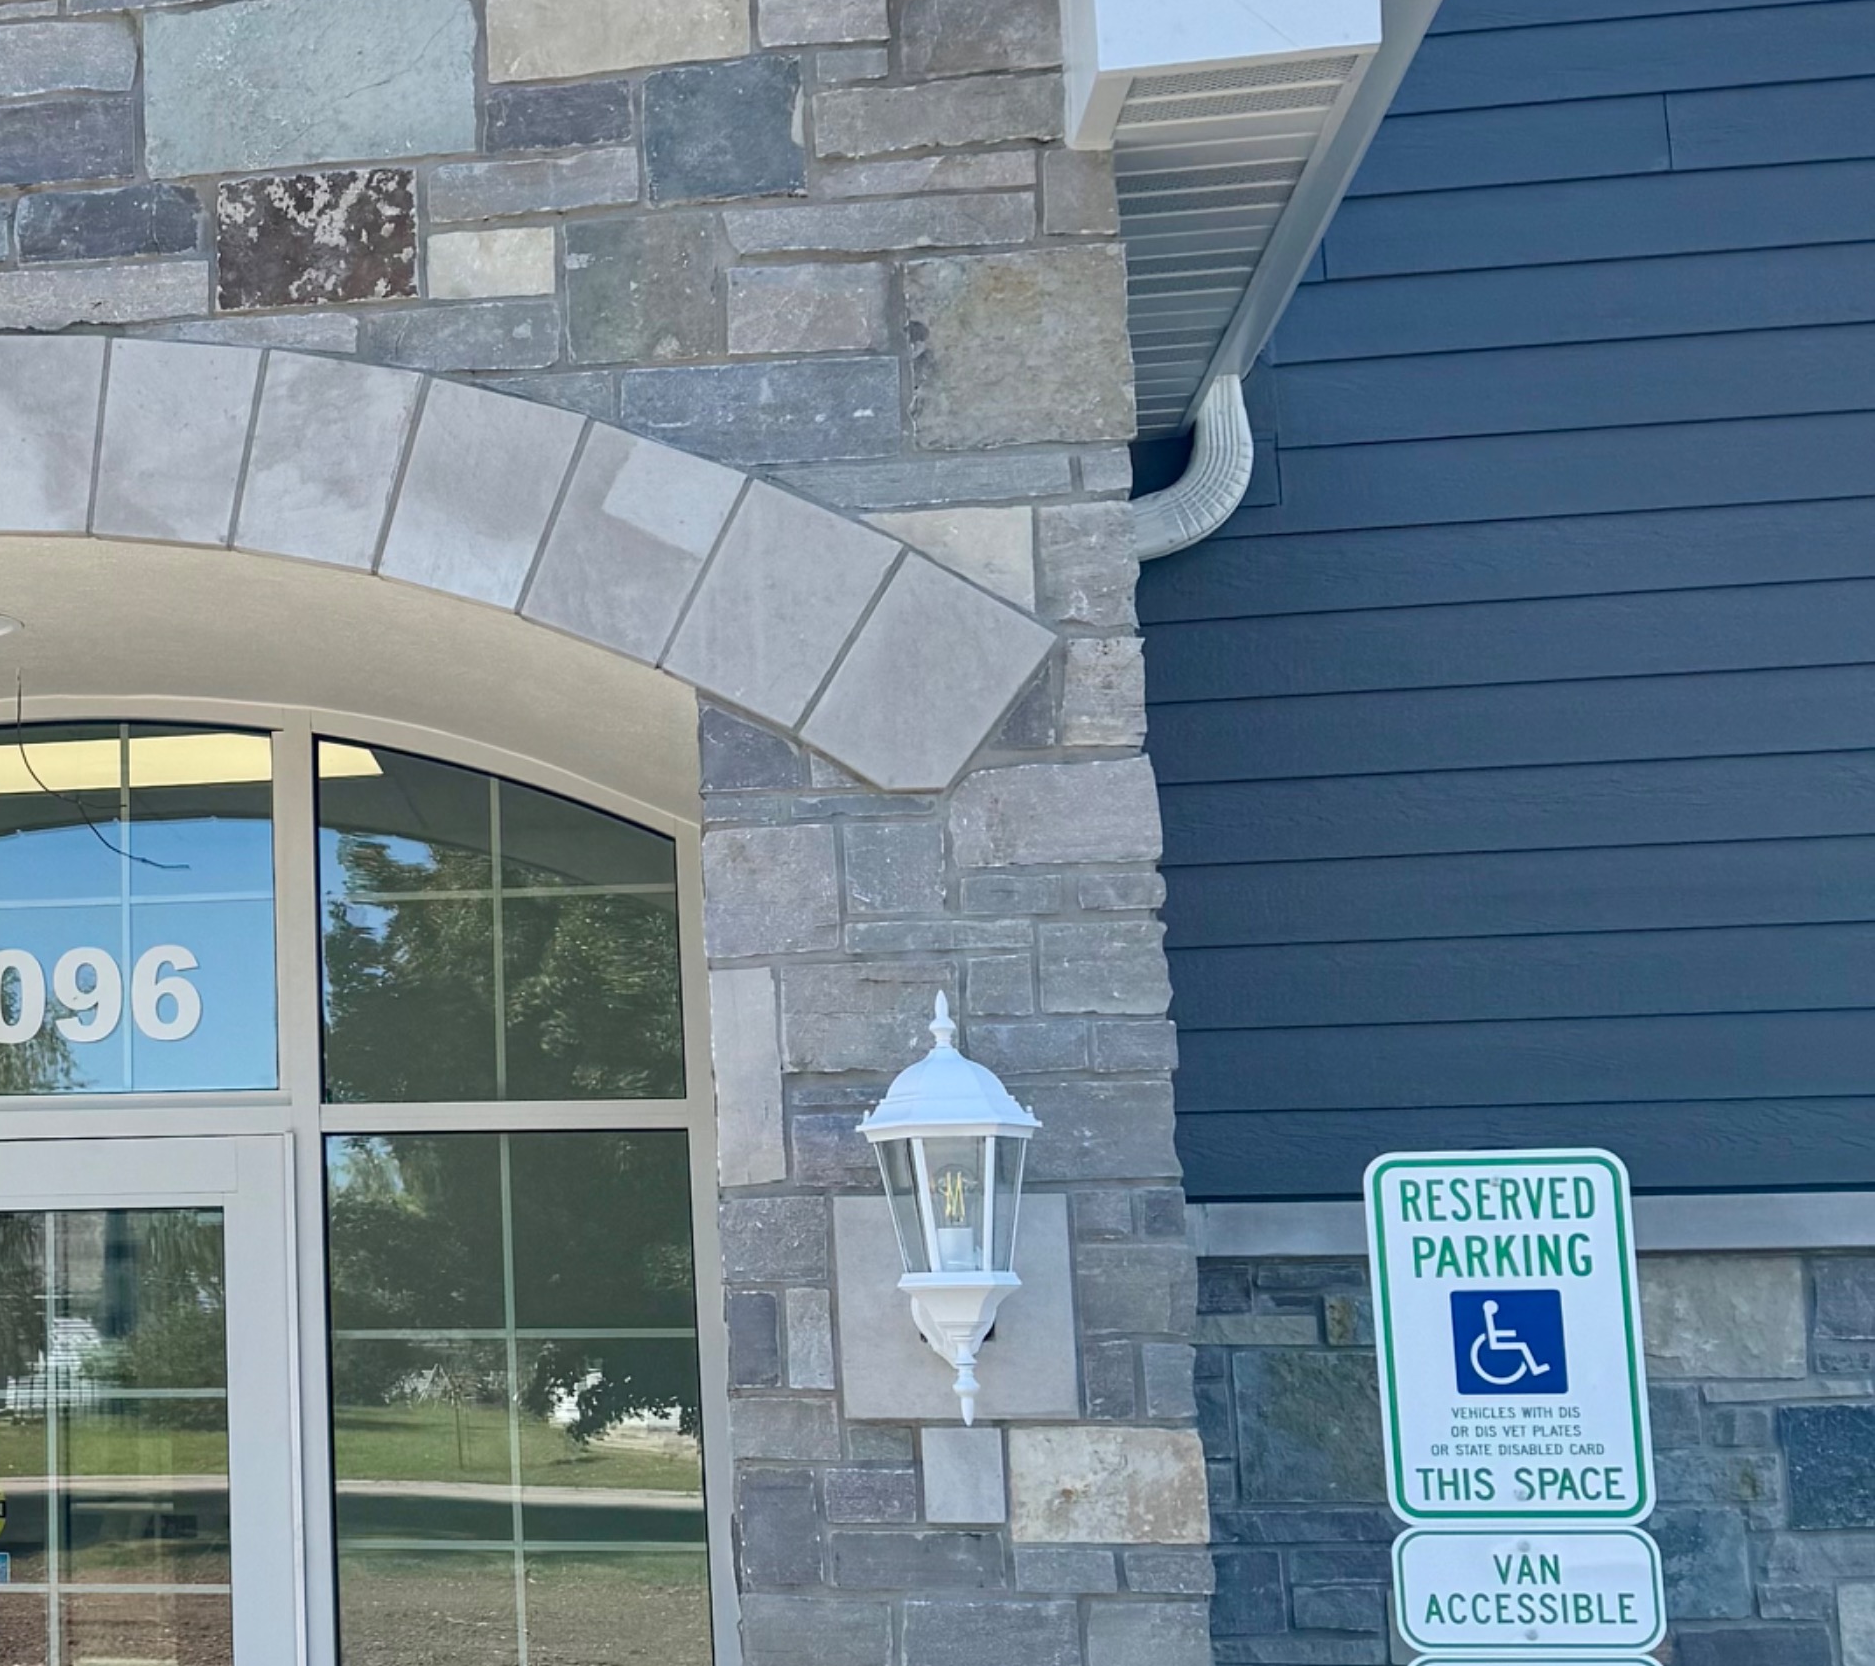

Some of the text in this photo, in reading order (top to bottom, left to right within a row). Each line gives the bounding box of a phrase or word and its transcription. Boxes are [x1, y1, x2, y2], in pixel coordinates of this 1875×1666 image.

[1399, 1177, 1596, 1223] RESERVED
[1411, 1233, 1594, 1278] PARKING
[1451, 1405, 1581, 1420] VEHICLES WITH DIS
[1450, 1424, 1582, 1438] OR DIS VET PLATES
[1431, 1442, 1605, 1456] OR STATE DISABLED CARD
[1415, 1467, 1626, 1502] THIS SPACE
[1493, 1554, 1562, 1585] VAN
[1425, 1593, 1639, 1624] ACCESSIBLE
